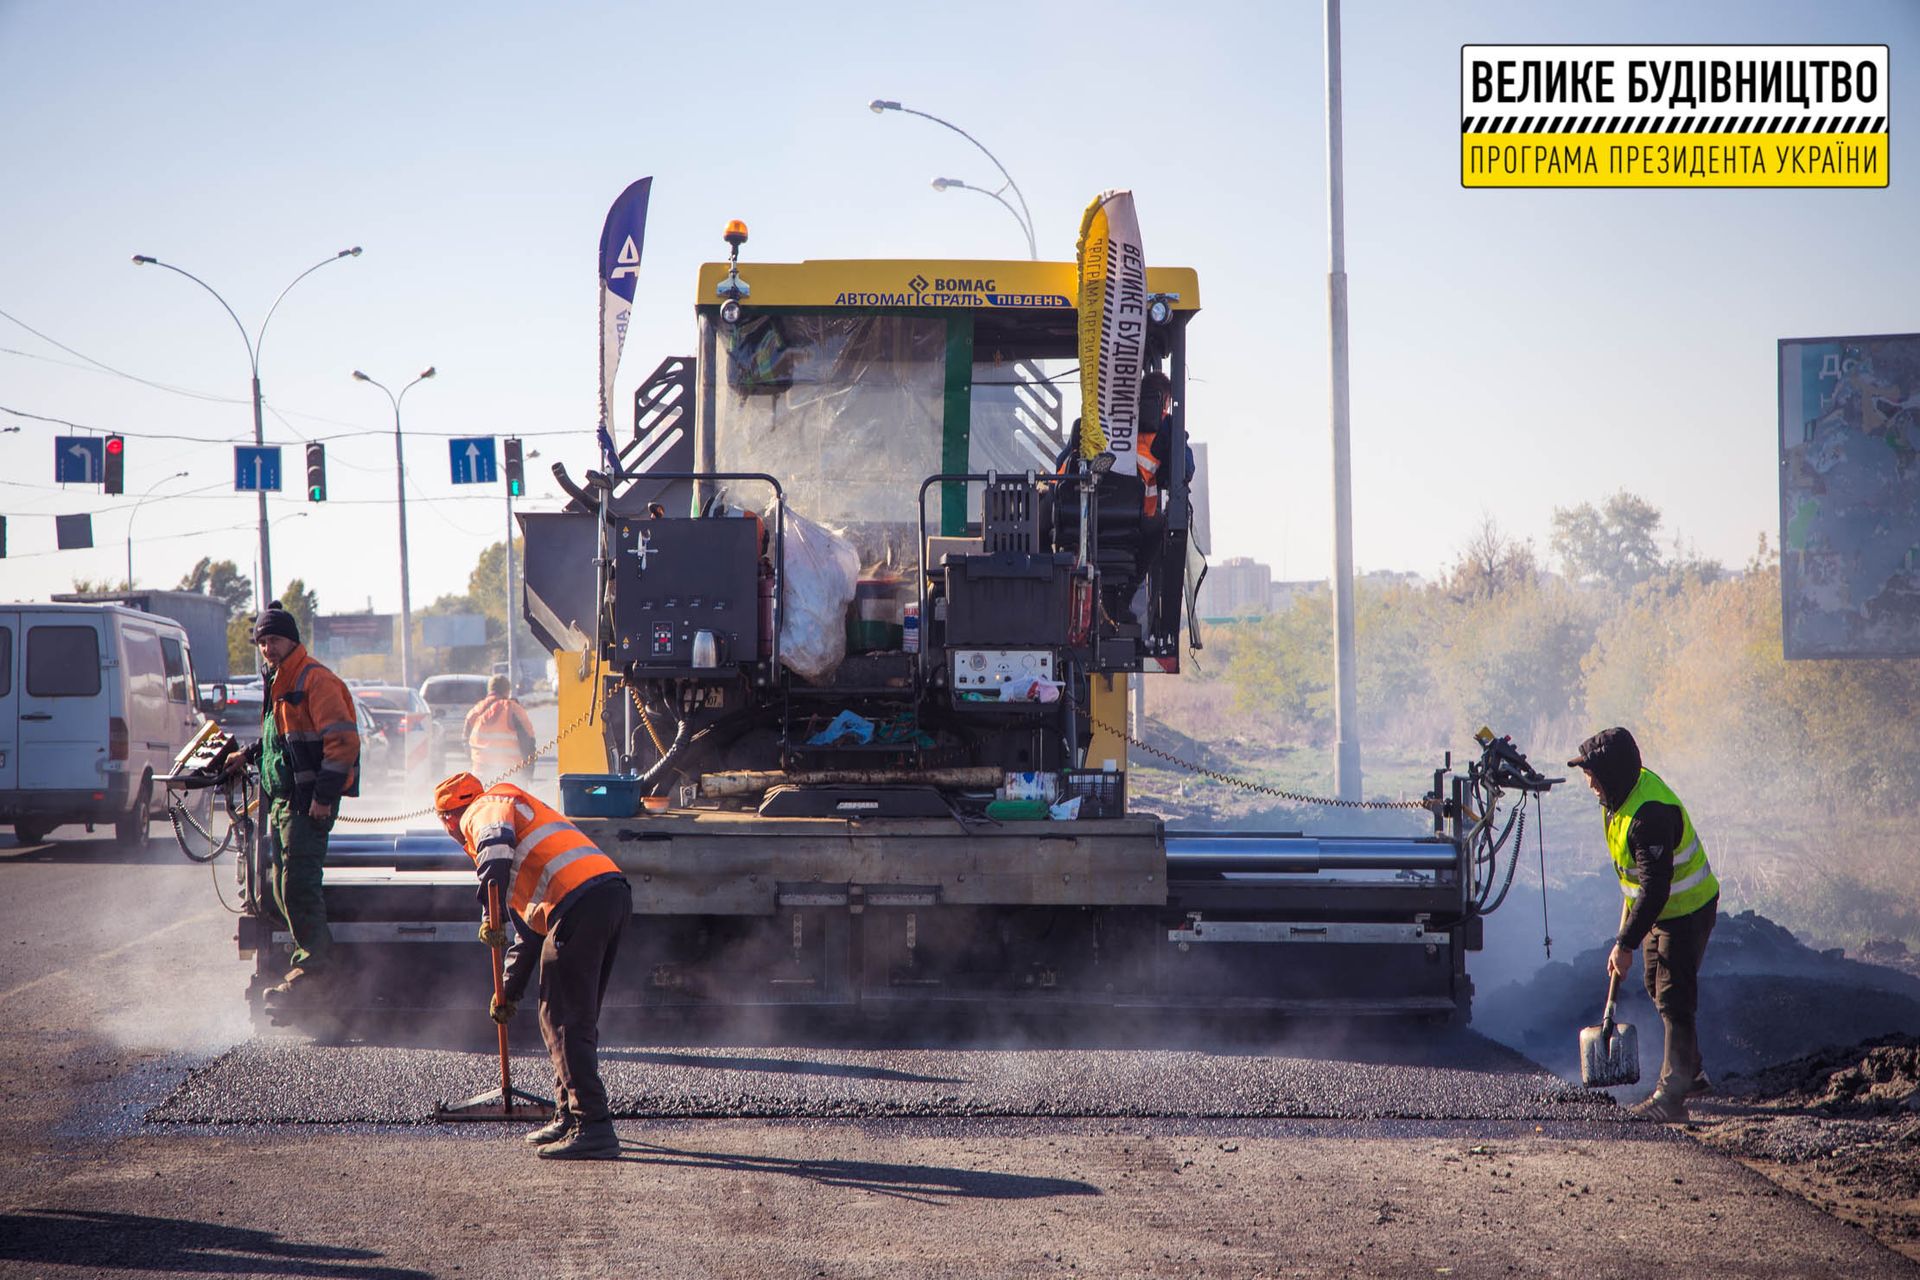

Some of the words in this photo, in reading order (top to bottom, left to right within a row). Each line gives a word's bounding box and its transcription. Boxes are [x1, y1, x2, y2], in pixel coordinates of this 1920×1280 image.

[835, 292, 984, 306] АВТОМАГІСТРАЛЬ
[996, 295, 1063, 306] ПІВДЕНЬ
[935, 278, 996, 292] BOMAG
[1119, 242, 1144, 317] ВЕЛИКЕ
[1108, 320, 1141, 452] БУДІВНИЦТВО
